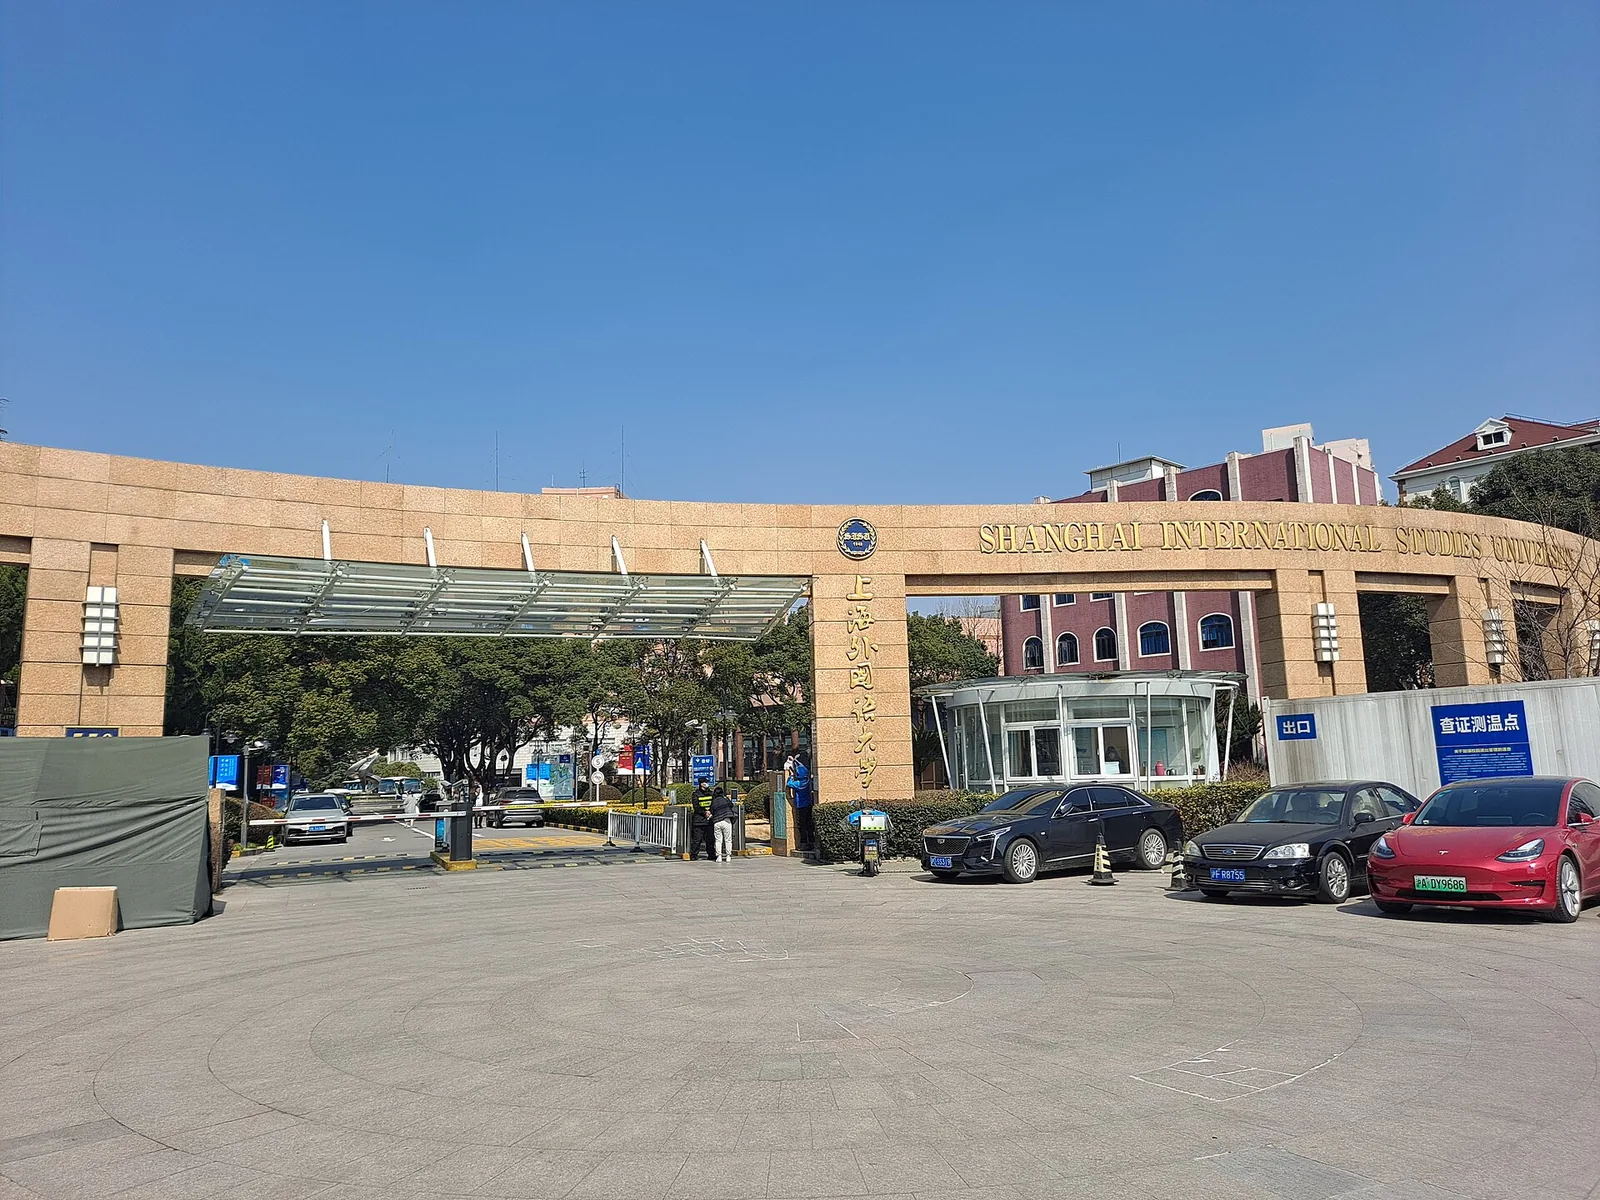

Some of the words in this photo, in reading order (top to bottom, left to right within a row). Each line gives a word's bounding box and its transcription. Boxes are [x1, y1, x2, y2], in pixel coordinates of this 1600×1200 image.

[979, 521, 1144, 554] SHANGHAI
[1159, 520, 1382, 552] INTERNATIONAL
[1395, 525, 1484, 560] STUDIES
[1282, 720, 1311, 735] 出口
[1439, 713, 1520, 735] 查证测温点
